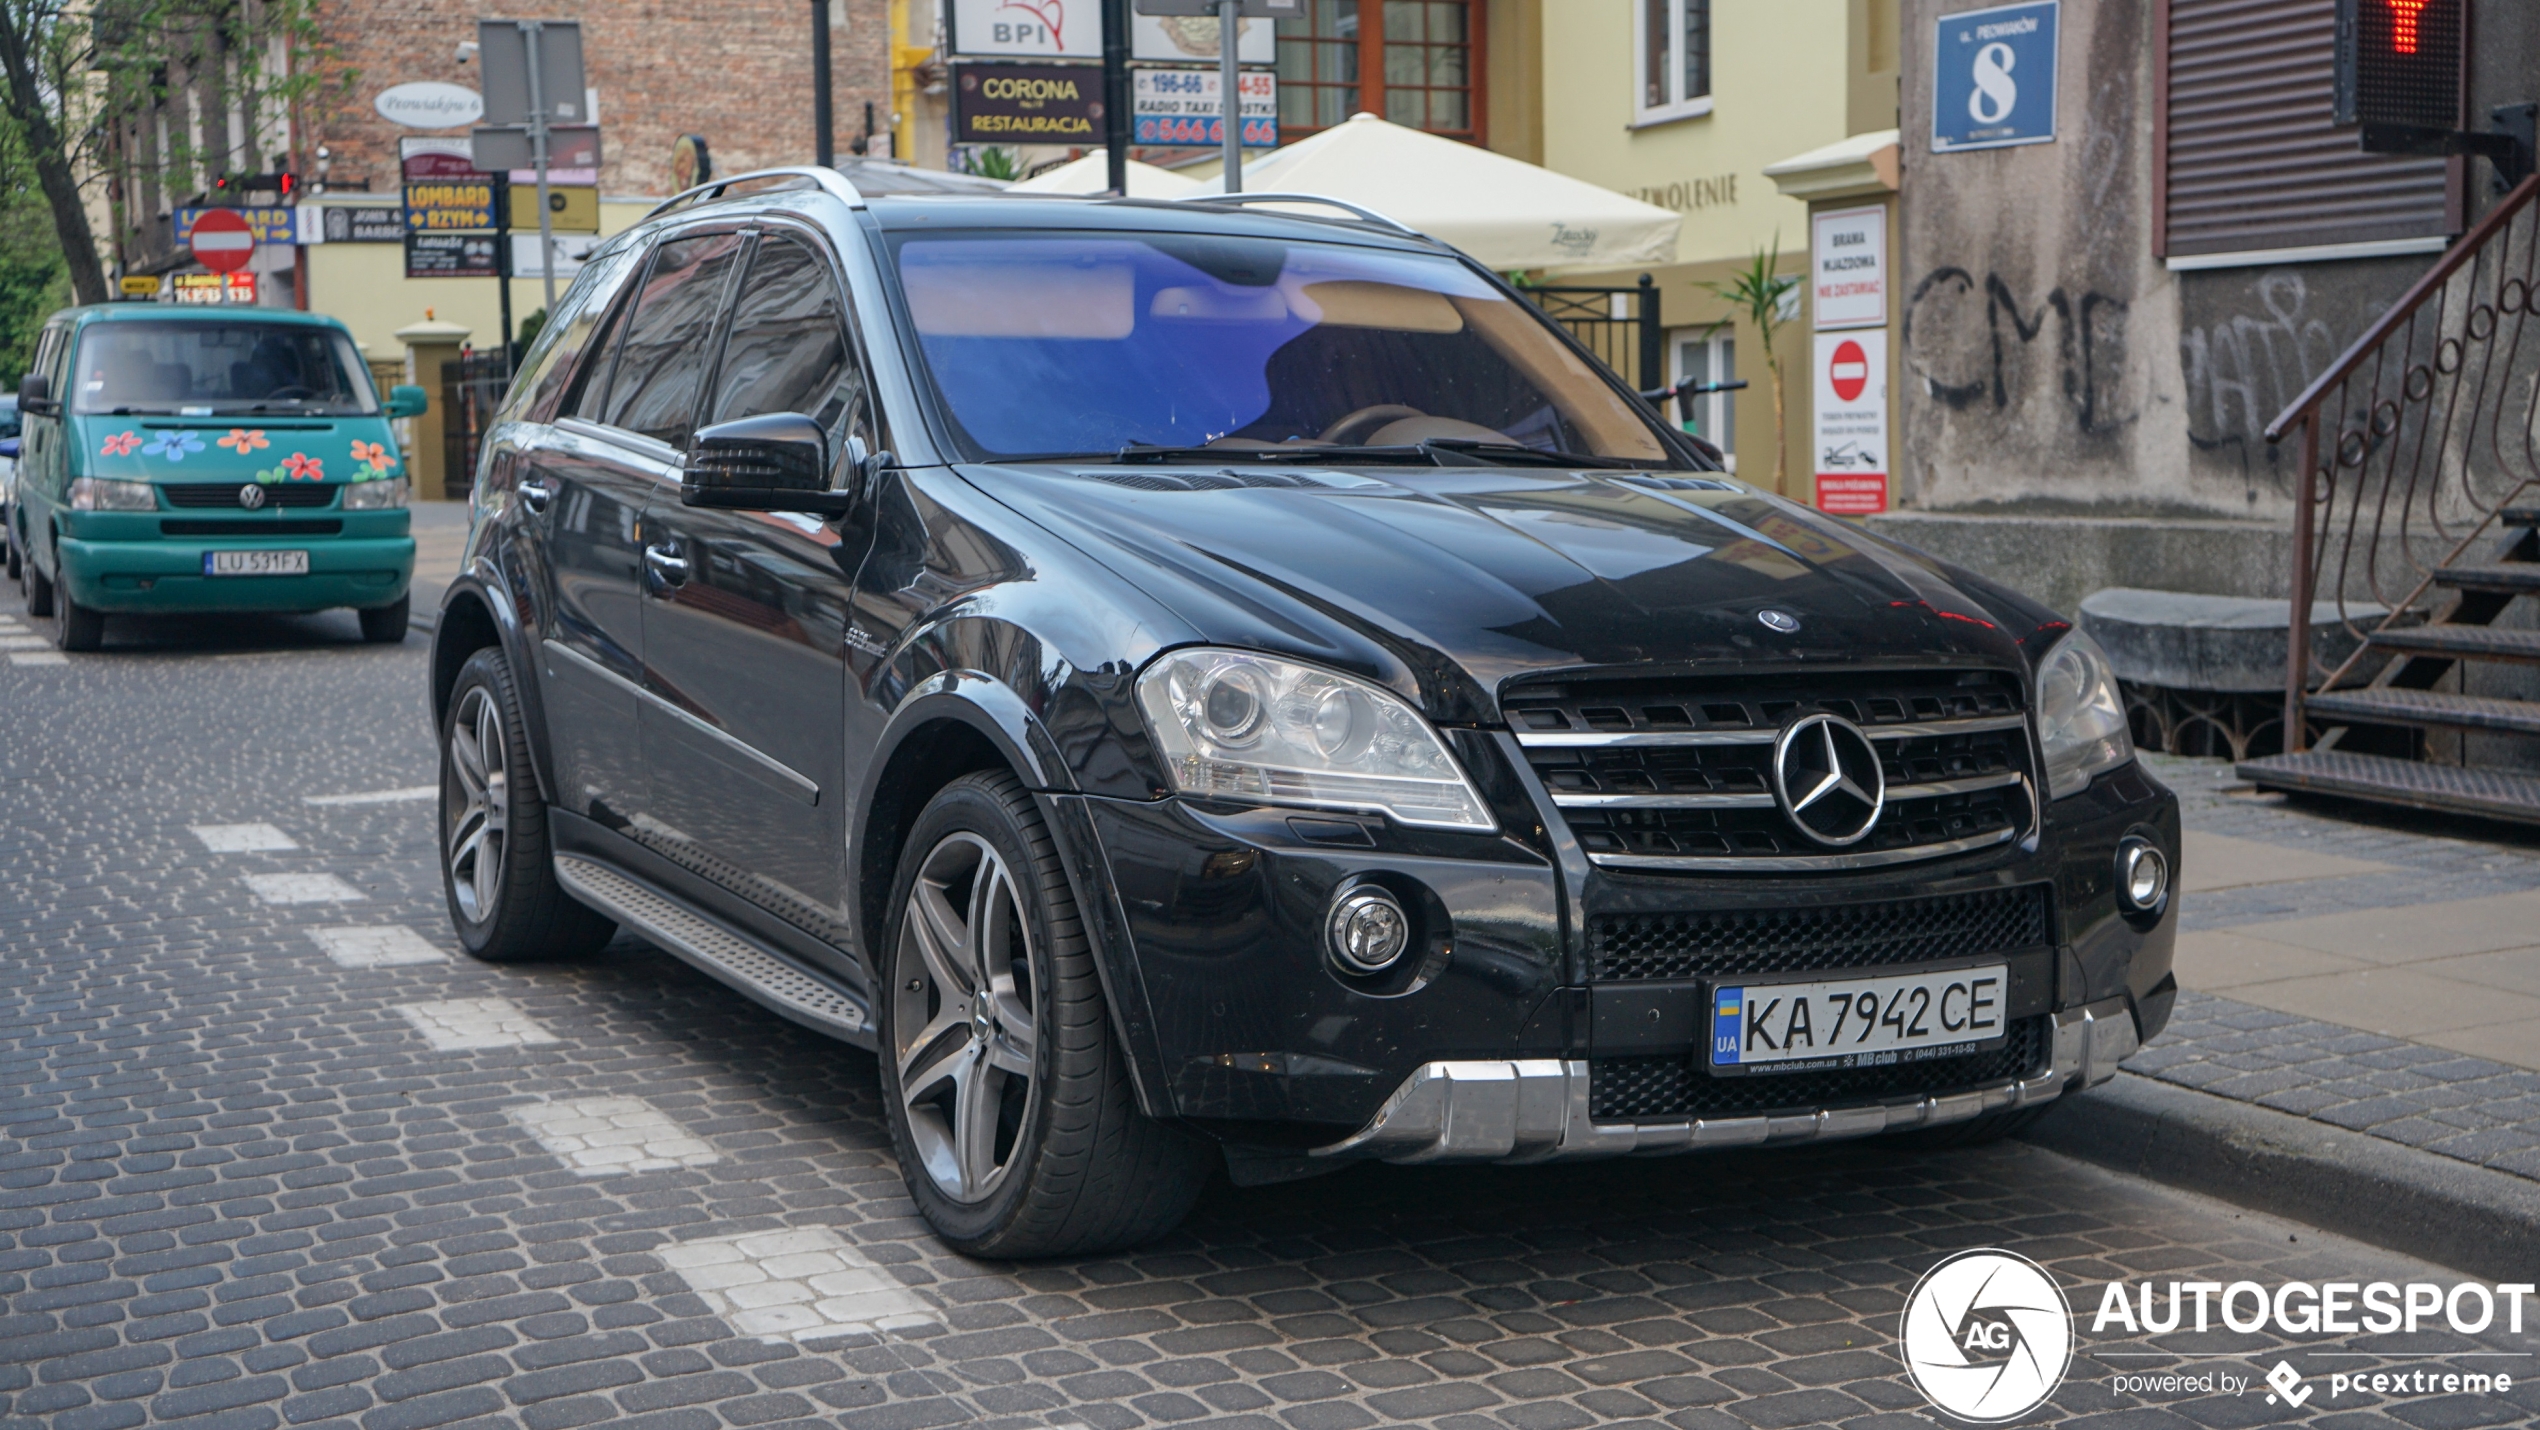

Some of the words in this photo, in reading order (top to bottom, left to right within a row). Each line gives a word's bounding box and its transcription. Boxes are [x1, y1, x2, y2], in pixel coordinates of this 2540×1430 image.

[994, 23, 1045, 44] BPI
[1976, 16, 2038, 40] PEOWIAKÓW
[982, 78, 1080, 100] CORONA
[1152, 73, 1203, 94] 196-66
[1968, 41, 2018, 124] 8
[1138, 100, 1181, 113] RADIO
[1185, 101, 1215, 114] TAXI
[971, 115, 1093, 133] RESTAURACJA
[1158, 119, 1207, 141] 566
[1243, 120, 1276, 143] 66
[407, 186, 491, 208] LOMBARD
[427, 210, 475, 228] RZYM
[1832, 232, 1866, 247] BRAMA
[1823, 255, 1876, 272] WJAZDOWA
[217, 553, 243, 571] LU
[250, 551, 304, 570] 531FX
[1745, 997, 1814, 1052] KA
[1829, 986, 1930, 1045] 7942
[1940, 977, 1998, 1032] CE
[1717, 1037, 1738, 1053] UA
[1750, 1058, 1837, 1073] www.mbclub.com.ua
[1856, 1053, 1875, 1067] MB
[1875, 1051, 1898, 1065] club
[1915, 1047, 1936, 1060] (044)
